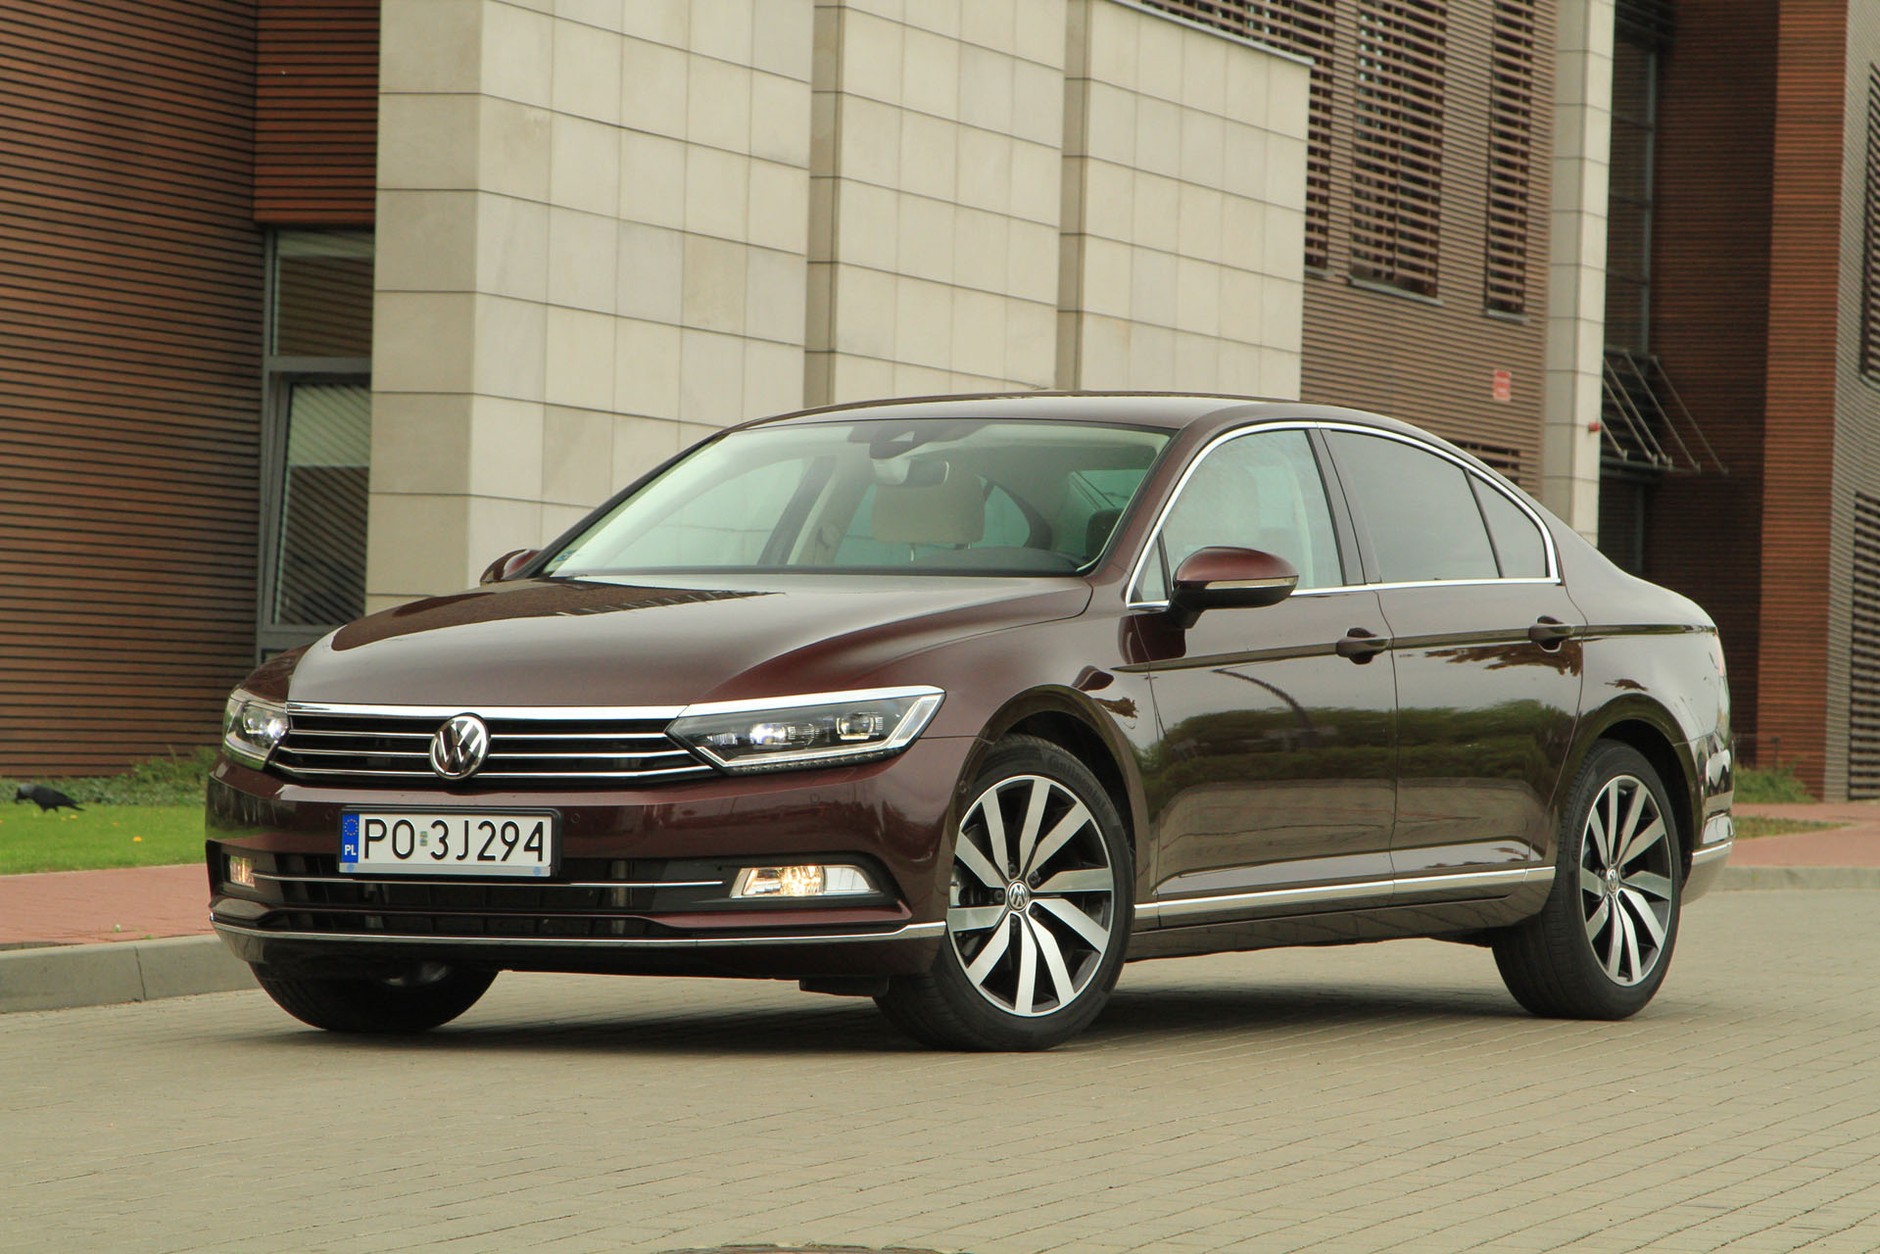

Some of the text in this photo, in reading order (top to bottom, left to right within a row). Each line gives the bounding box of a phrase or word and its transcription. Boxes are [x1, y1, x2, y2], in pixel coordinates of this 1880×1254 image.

[344, 844, 357, 856] PL
[364, 818, 544, 862] PO 3J294
